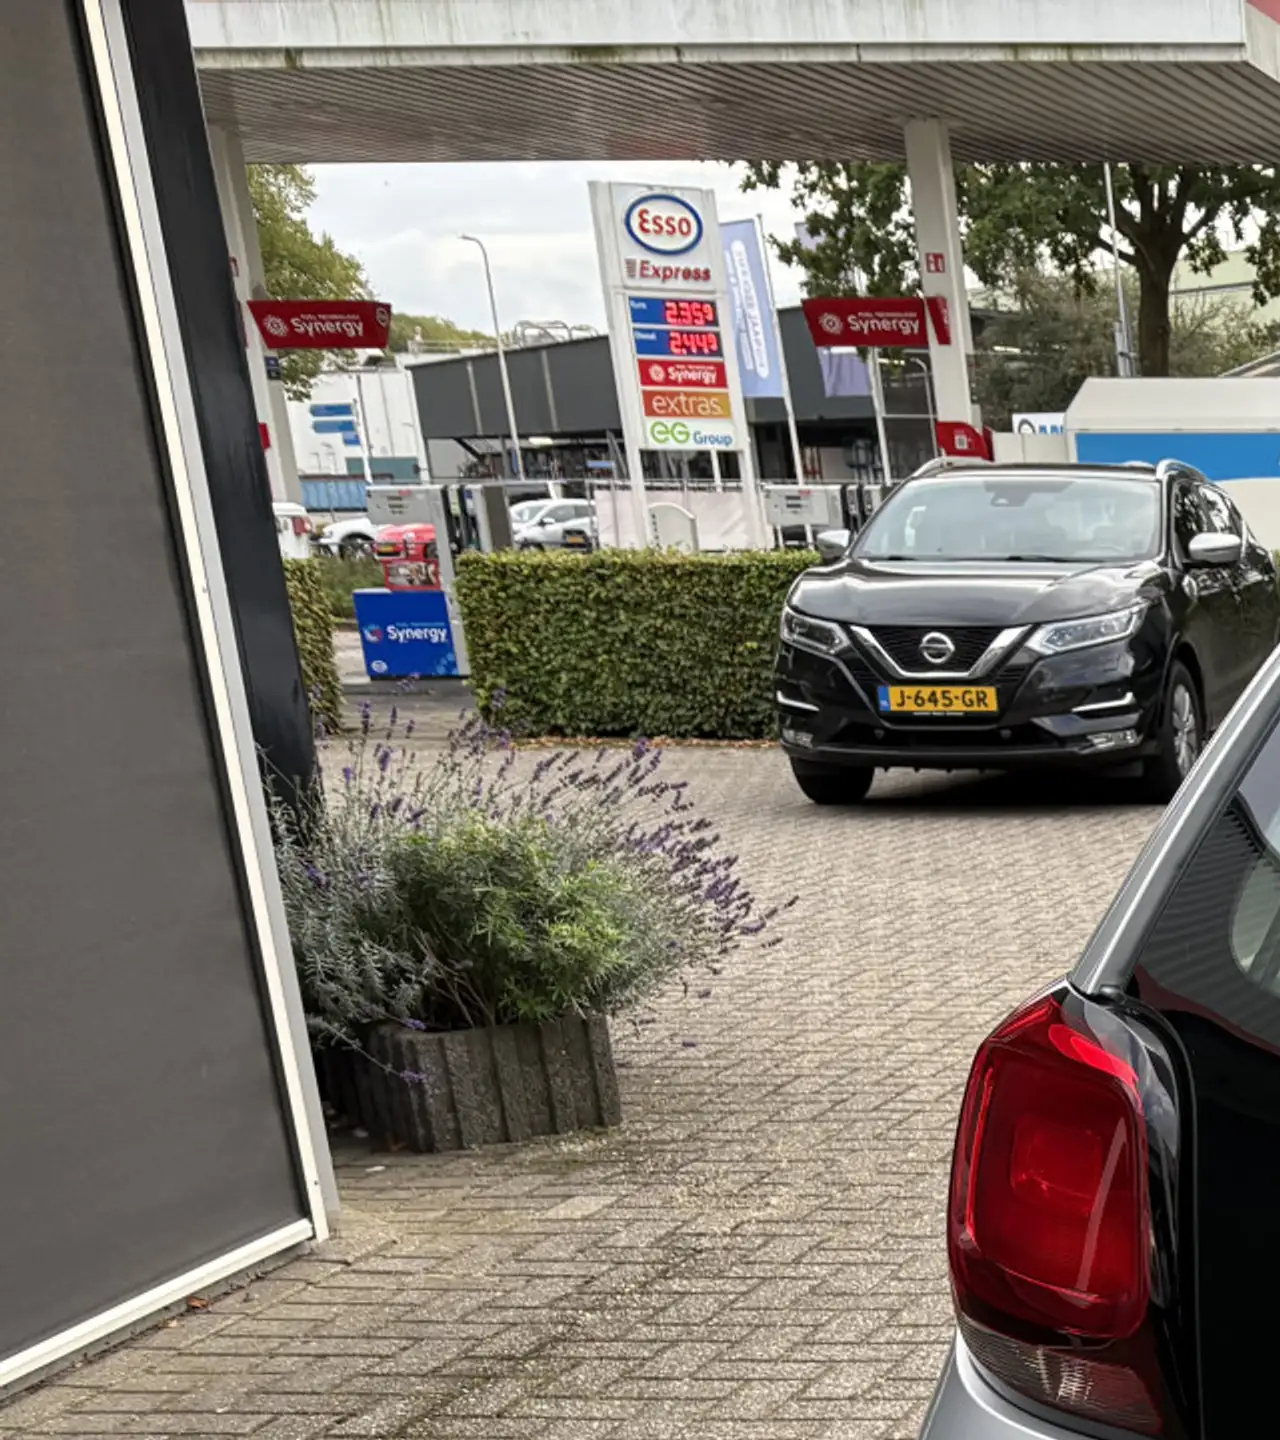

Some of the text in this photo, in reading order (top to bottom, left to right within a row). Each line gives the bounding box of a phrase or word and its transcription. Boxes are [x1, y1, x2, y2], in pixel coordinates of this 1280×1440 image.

[640, 260, 711, 283] Express
[290, 317, 364, 338] Synergy
[847, 313, 920, 335] Synergy
[667, 365, 717, 384] Synergy
[652, 392, 723, 416] extras
[693, 430, 733, 447] Group
[386, 625, 448, 643] Synergy
[896, 690, 988, 707] J-645-GR
